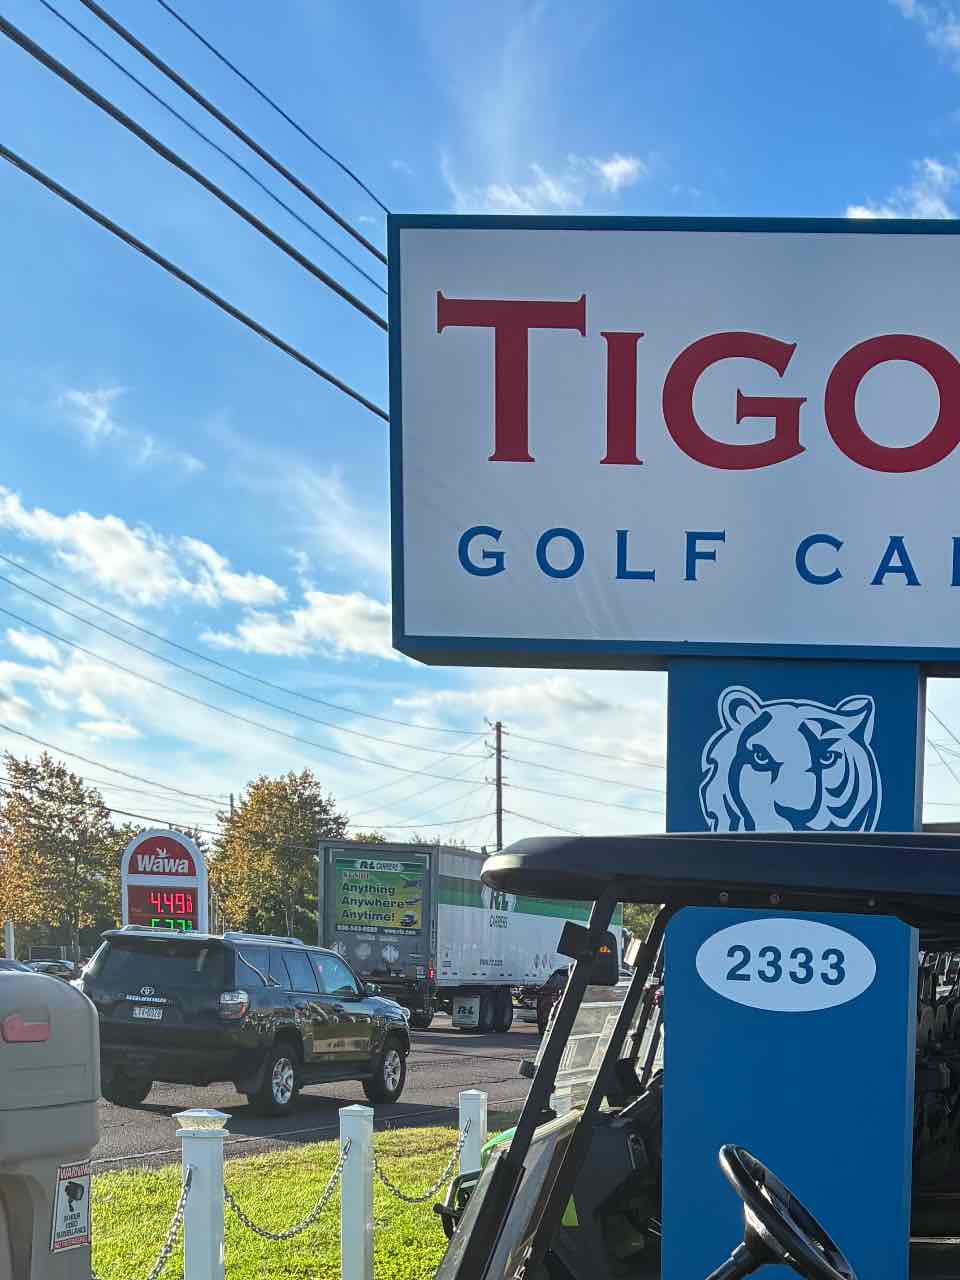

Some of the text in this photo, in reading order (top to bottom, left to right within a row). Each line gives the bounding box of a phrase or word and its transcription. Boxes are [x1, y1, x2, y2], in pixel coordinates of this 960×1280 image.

[458, 526, 725, 582] GOLF
[136, 854, 189, 873] Wawa
[342, 883, 396, 896] Anything
[341, 896, 404, 909] Anywhere
[342, 910, 395, 922] Anytime!
[726, 945, 845, 985] 2333
